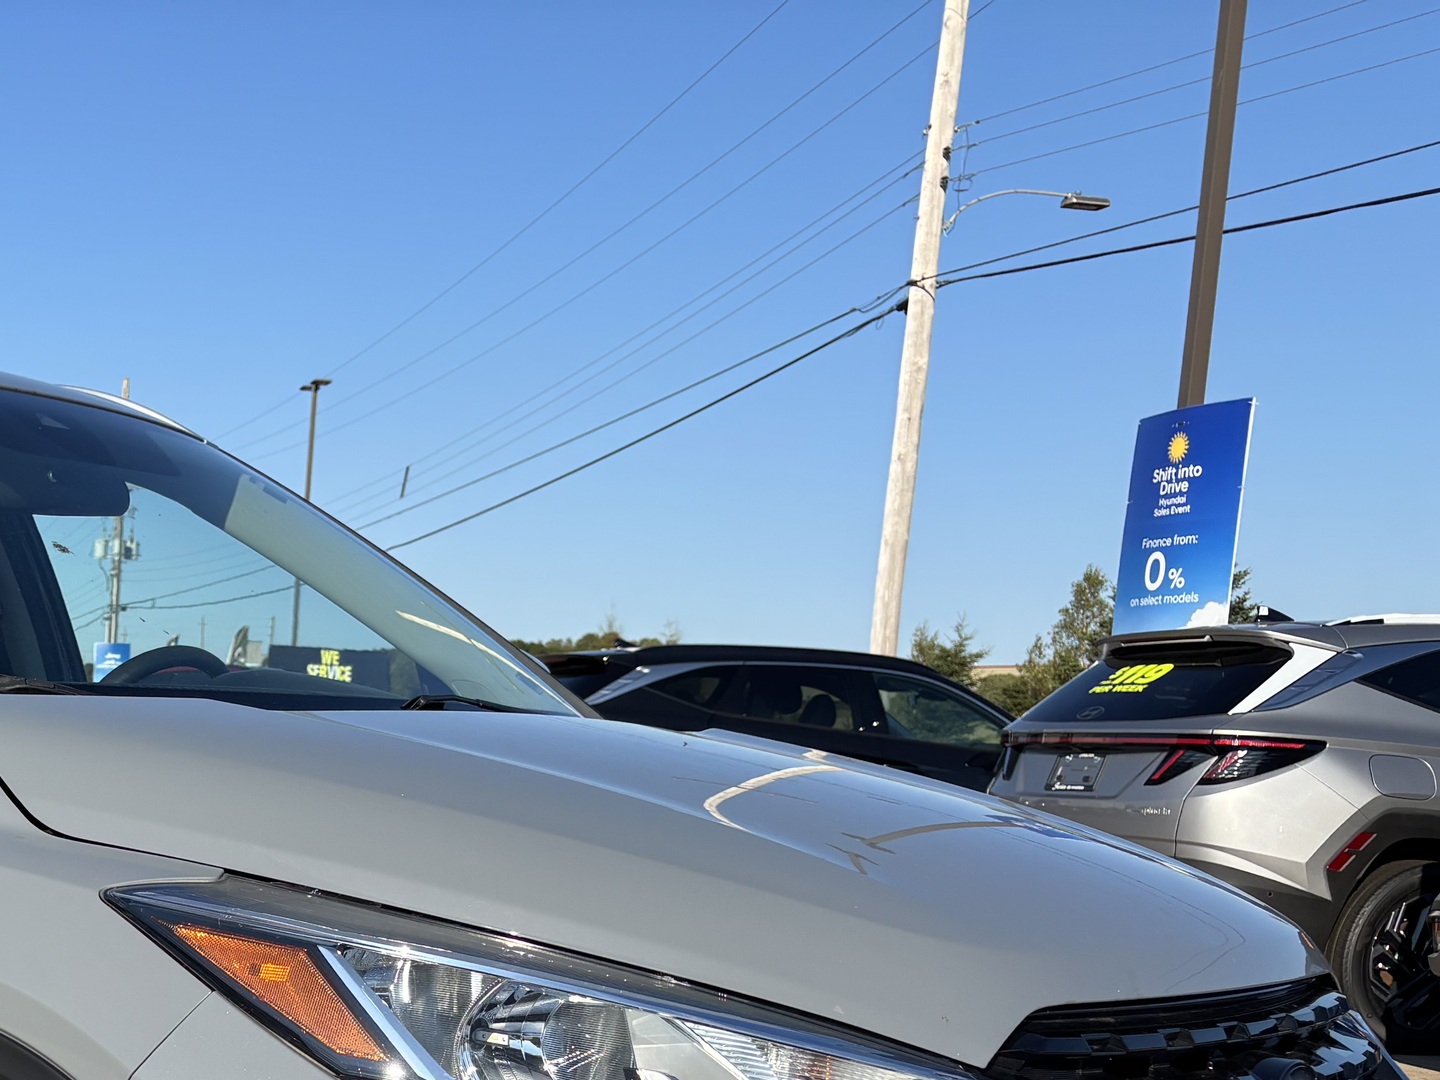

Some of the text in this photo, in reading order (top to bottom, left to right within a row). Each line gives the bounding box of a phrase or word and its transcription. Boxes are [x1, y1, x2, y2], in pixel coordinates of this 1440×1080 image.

[1152, 464, 1203, 483] Shift into
[1159, 479, 1189, 496] Drive
[1158, 494, 1187, 507] Hyundai
[1153, 505, 1191, 517] Sales Event
[1142, 534, 1199, 549] Finance from:
[1130, 591, 1200, 608] on select models
[320, 649, 341, 666] WE
[306, 663, 353, 684] SERVICE
[1108, 663, 1175, 685] $119
[1111, 683, 1150, 693] WEEK
